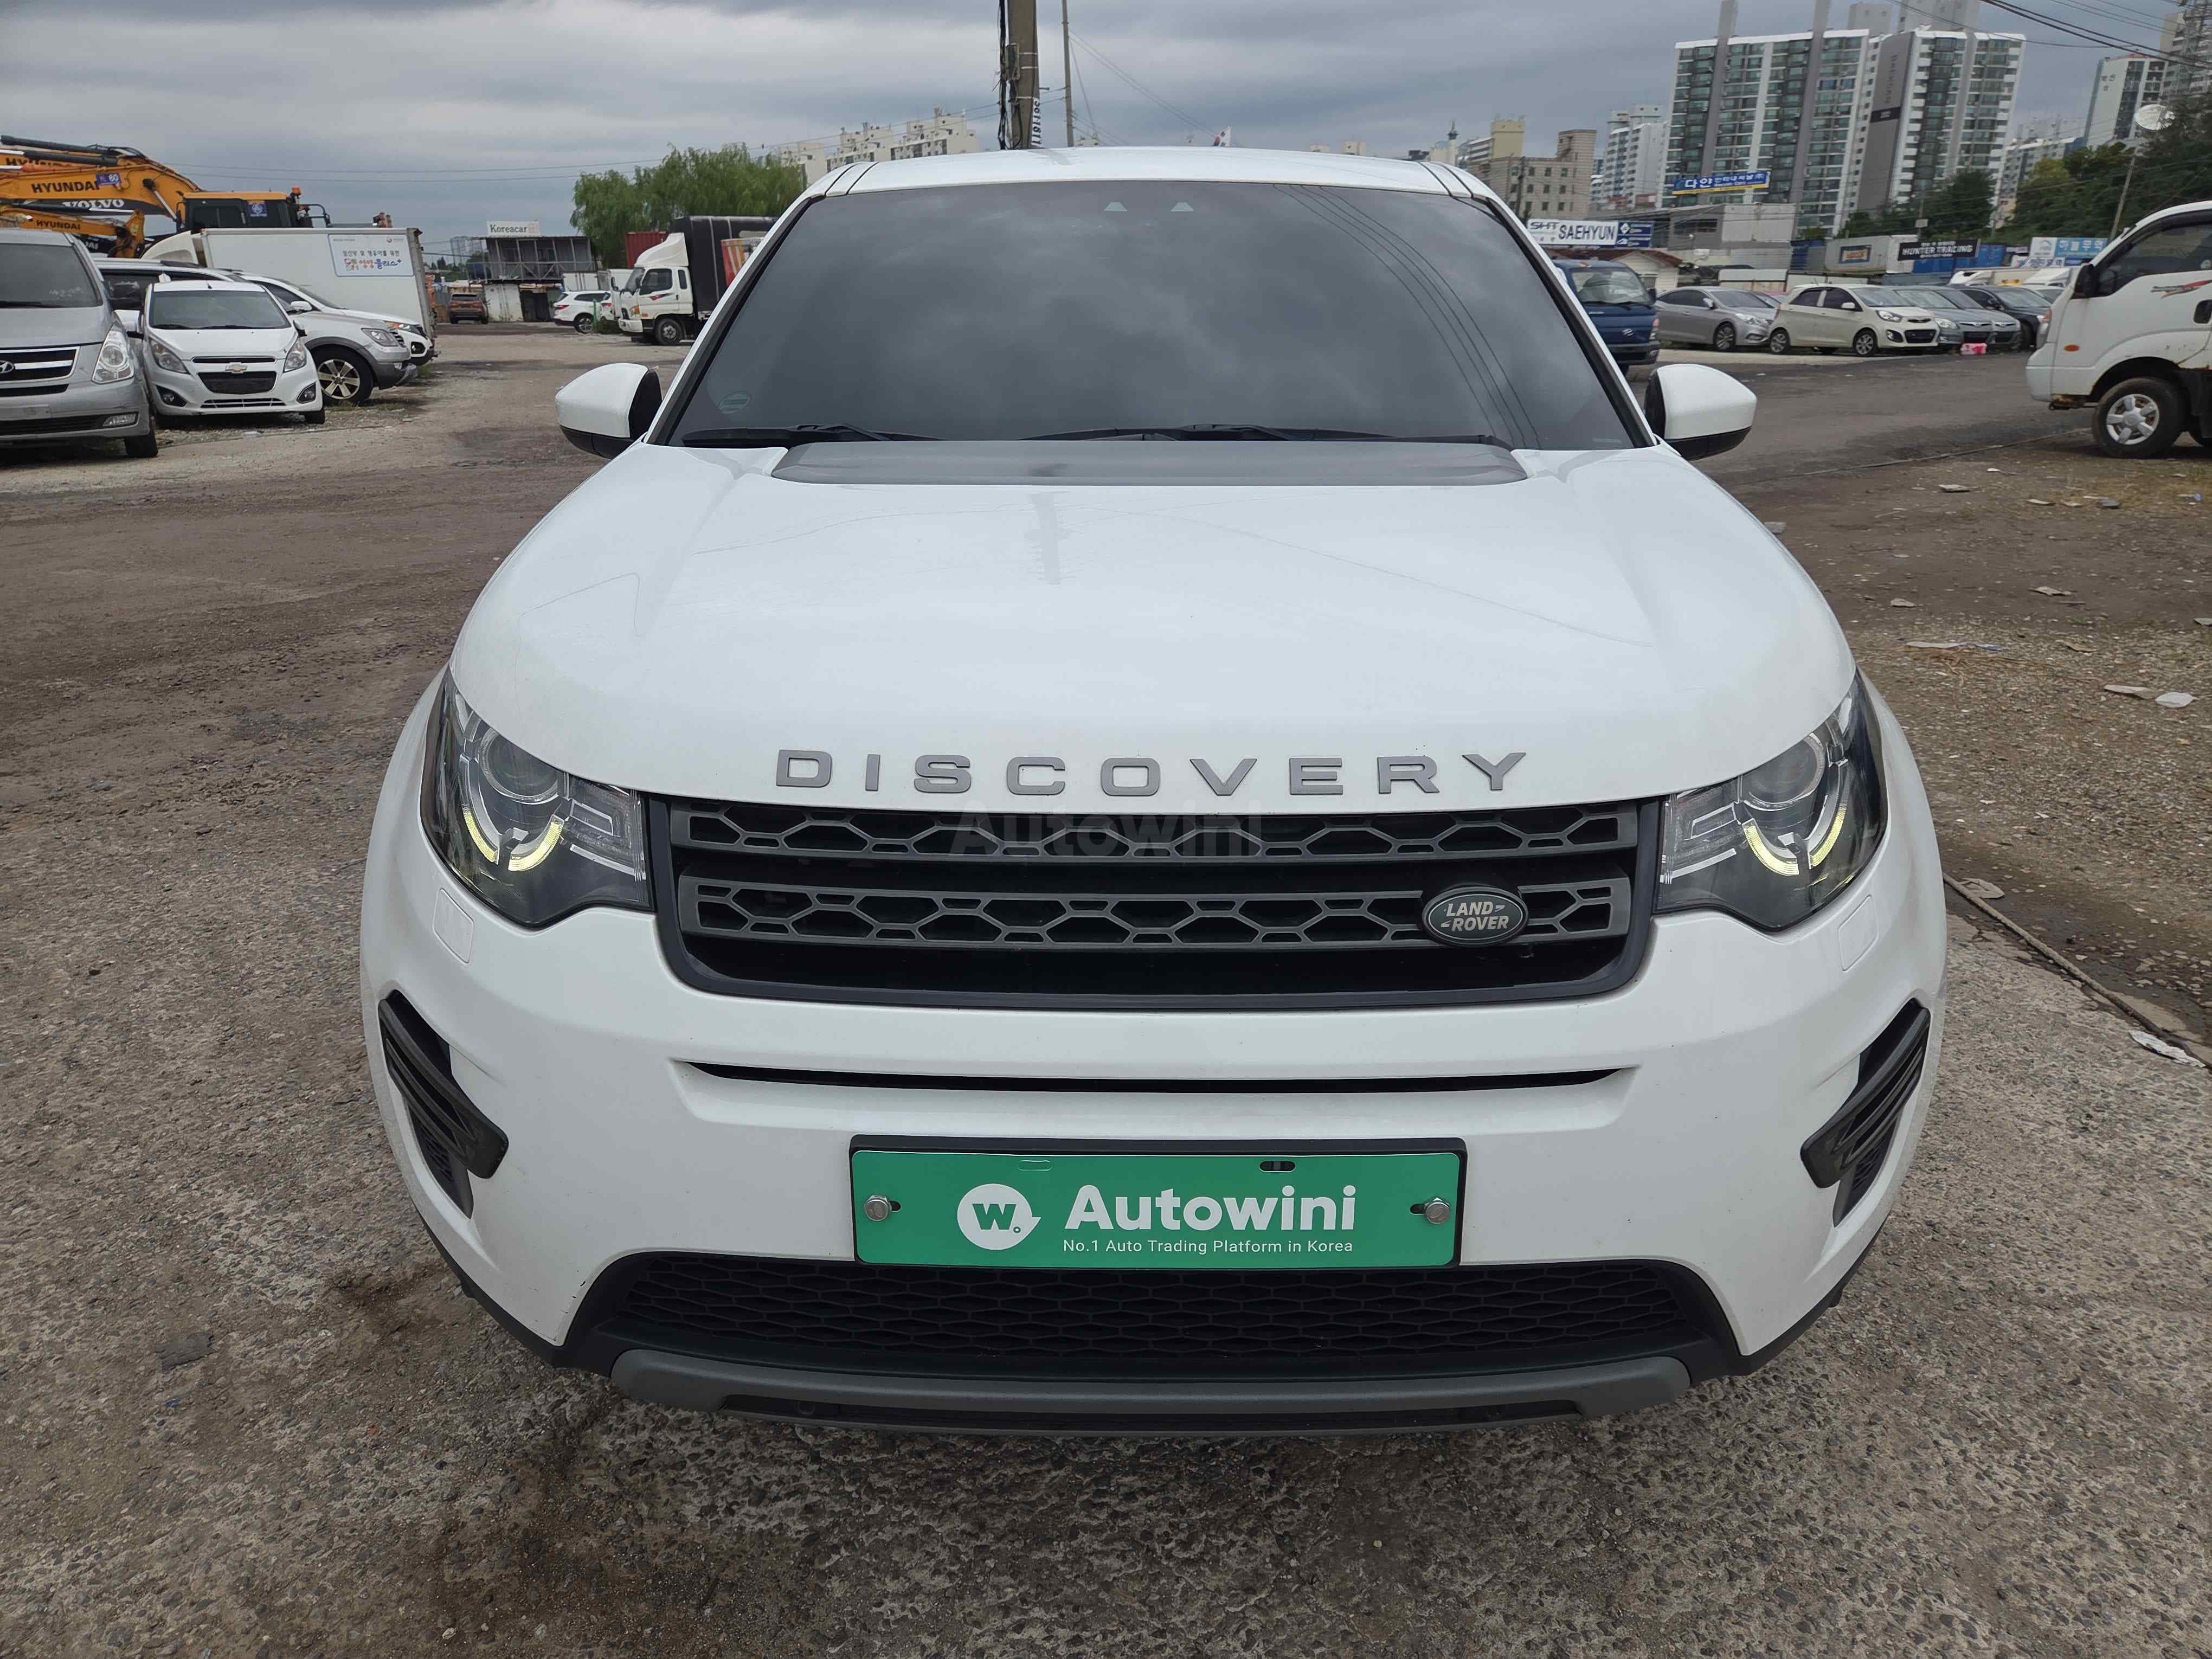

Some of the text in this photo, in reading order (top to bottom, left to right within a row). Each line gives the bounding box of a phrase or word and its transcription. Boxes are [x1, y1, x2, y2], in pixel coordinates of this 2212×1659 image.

[31, 181, 100, 194] HYUNDAI
[62, 199, 124, 208] VOLVO
[36, 220, 81, 230] HYUNDAI
[490, 224, 528, 233] Koreacar
[1558, 224, 1615, 240] SAEHYUN
[1902, 247, 1935, 255] HUNTER
[776, 749, 1526, 796] DISCOVERY
[1446, 901, 1493, 916] LAND
[1451, 915, 1509, 931] ROVER
[1064, 1185, 1356, 1231] Autowini
[1063, 1239, 1353, 1255] No.1 Auto Trading Platform in Korea
